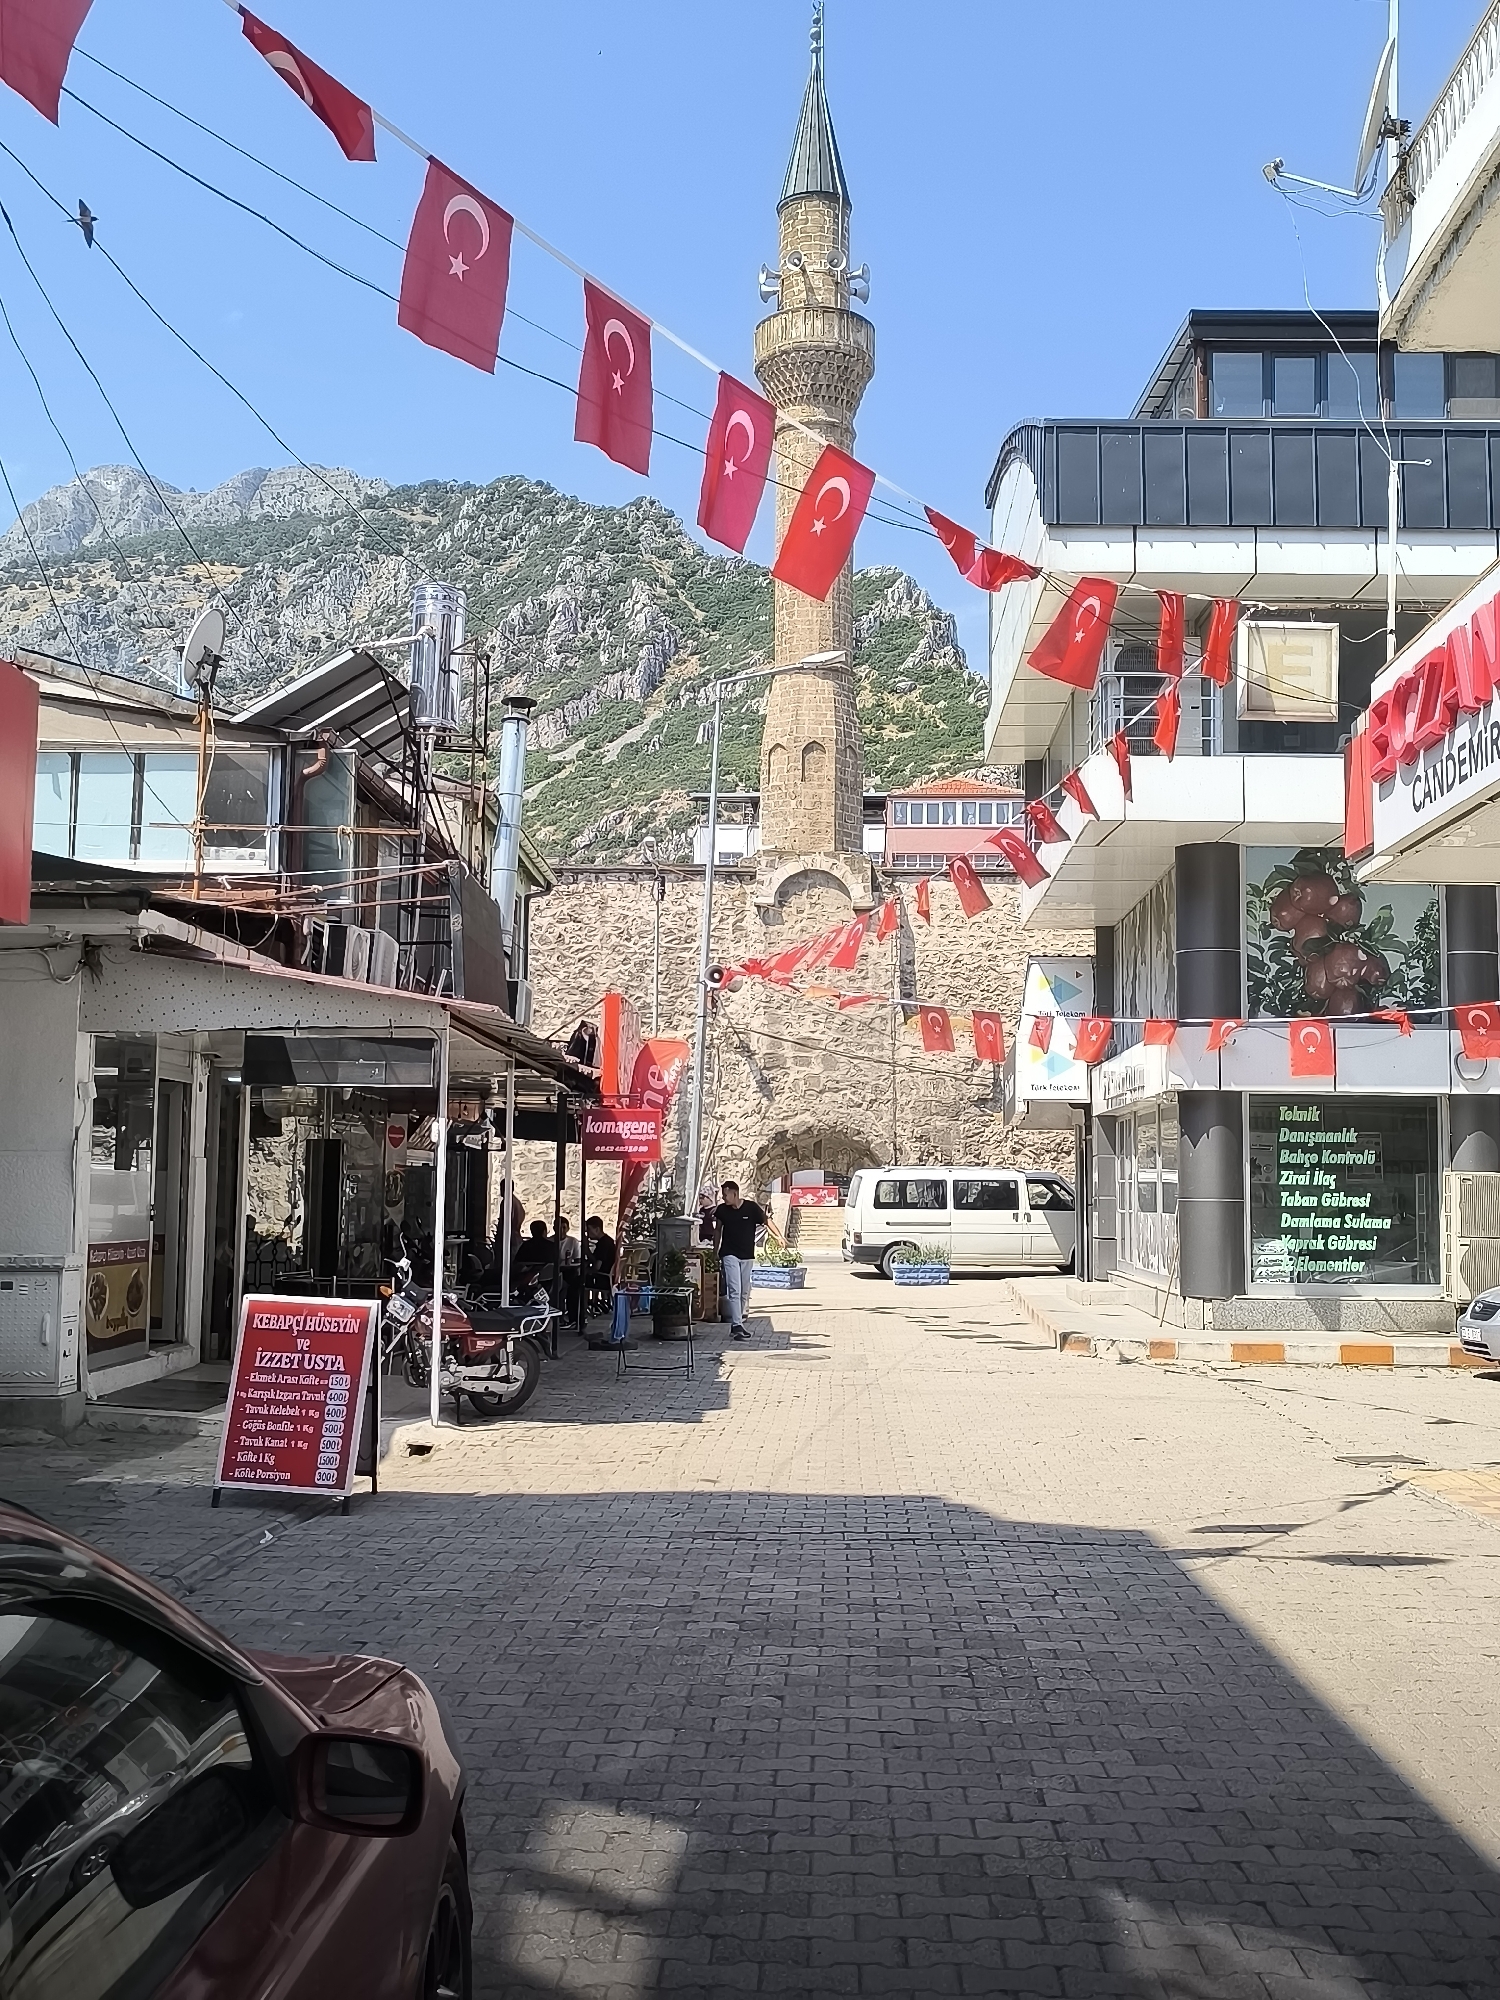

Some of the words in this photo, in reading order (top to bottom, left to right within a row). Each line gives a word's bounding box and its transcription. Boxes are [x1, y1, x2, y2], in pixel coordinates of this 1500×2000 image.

[1031, 1083, 1048, 1092] Türk
[1049, 1083, 1081, 1092] Telekom
[1279, 1105, 1320, 1121] Teknik
[585, 1115, 656, 1140] komagene
[1279, 1128, 1358, 1147] Danışmanlık
[1279, 1149, 1319, 1167] Bahçe
[1321, 1149, 1376, 1165] Kontrolü
[1279, 1170, 1311, 1185] Zirai
[1313, 1168, 1336, 1189] İlaç
[1280, 1190, 1319, 1207] Taban
[1321, 1192, 1371, 1208] Gübresi
[1280, 1212, 1341, 1228] Damlama
[1344, 1212, 1392, 1229] Sulama
[1280, 1234, 1326, 1253] Yaprak
[1327, 1235, 1378, 1251] Gübresi
[1296, 1256, 1366, 1272] Elementler
[305, 1312, 360, 1333] HÜSEYİN
[296, 1338, 311, 1351] ve
[254, 1346, 301, 1369] İZZET
[303, 1353, 345, 1371] USTA
[249, 1372, 276, 1383] Ekmek
[277, 1374, 298, 1384] Arası
[299, 1374, 320, 1385] Köfte
[247, 1388, 275, 1401] Karışık
[276, 1389, 300, 1401] Izgara
[301, 1391, 325, 1402] Tavuk
[245, 1404, 269, 1415] Tavuk
[269, 1405, 300, 1416] Kelebek
[308, 1409, 320, 1418] Kg
[242, 1419, 266, 1432] Göğüs
[266, 1421, 295, 1432] Bonfile
[302, 1424, 314, 1433] Kg
[240, 1436, 263, 1446] Tavuk
[264, 1437, 288, 1447] Kanat
[297, 1440, 308, 1450] Kg
[236, 1451, 257, 1463] Köfte
[264, 1453, 275, 1465] Kg
[234, 1468, 255, 1479] Köfte
[256, 1469, 291, 1481] Porsiyon
